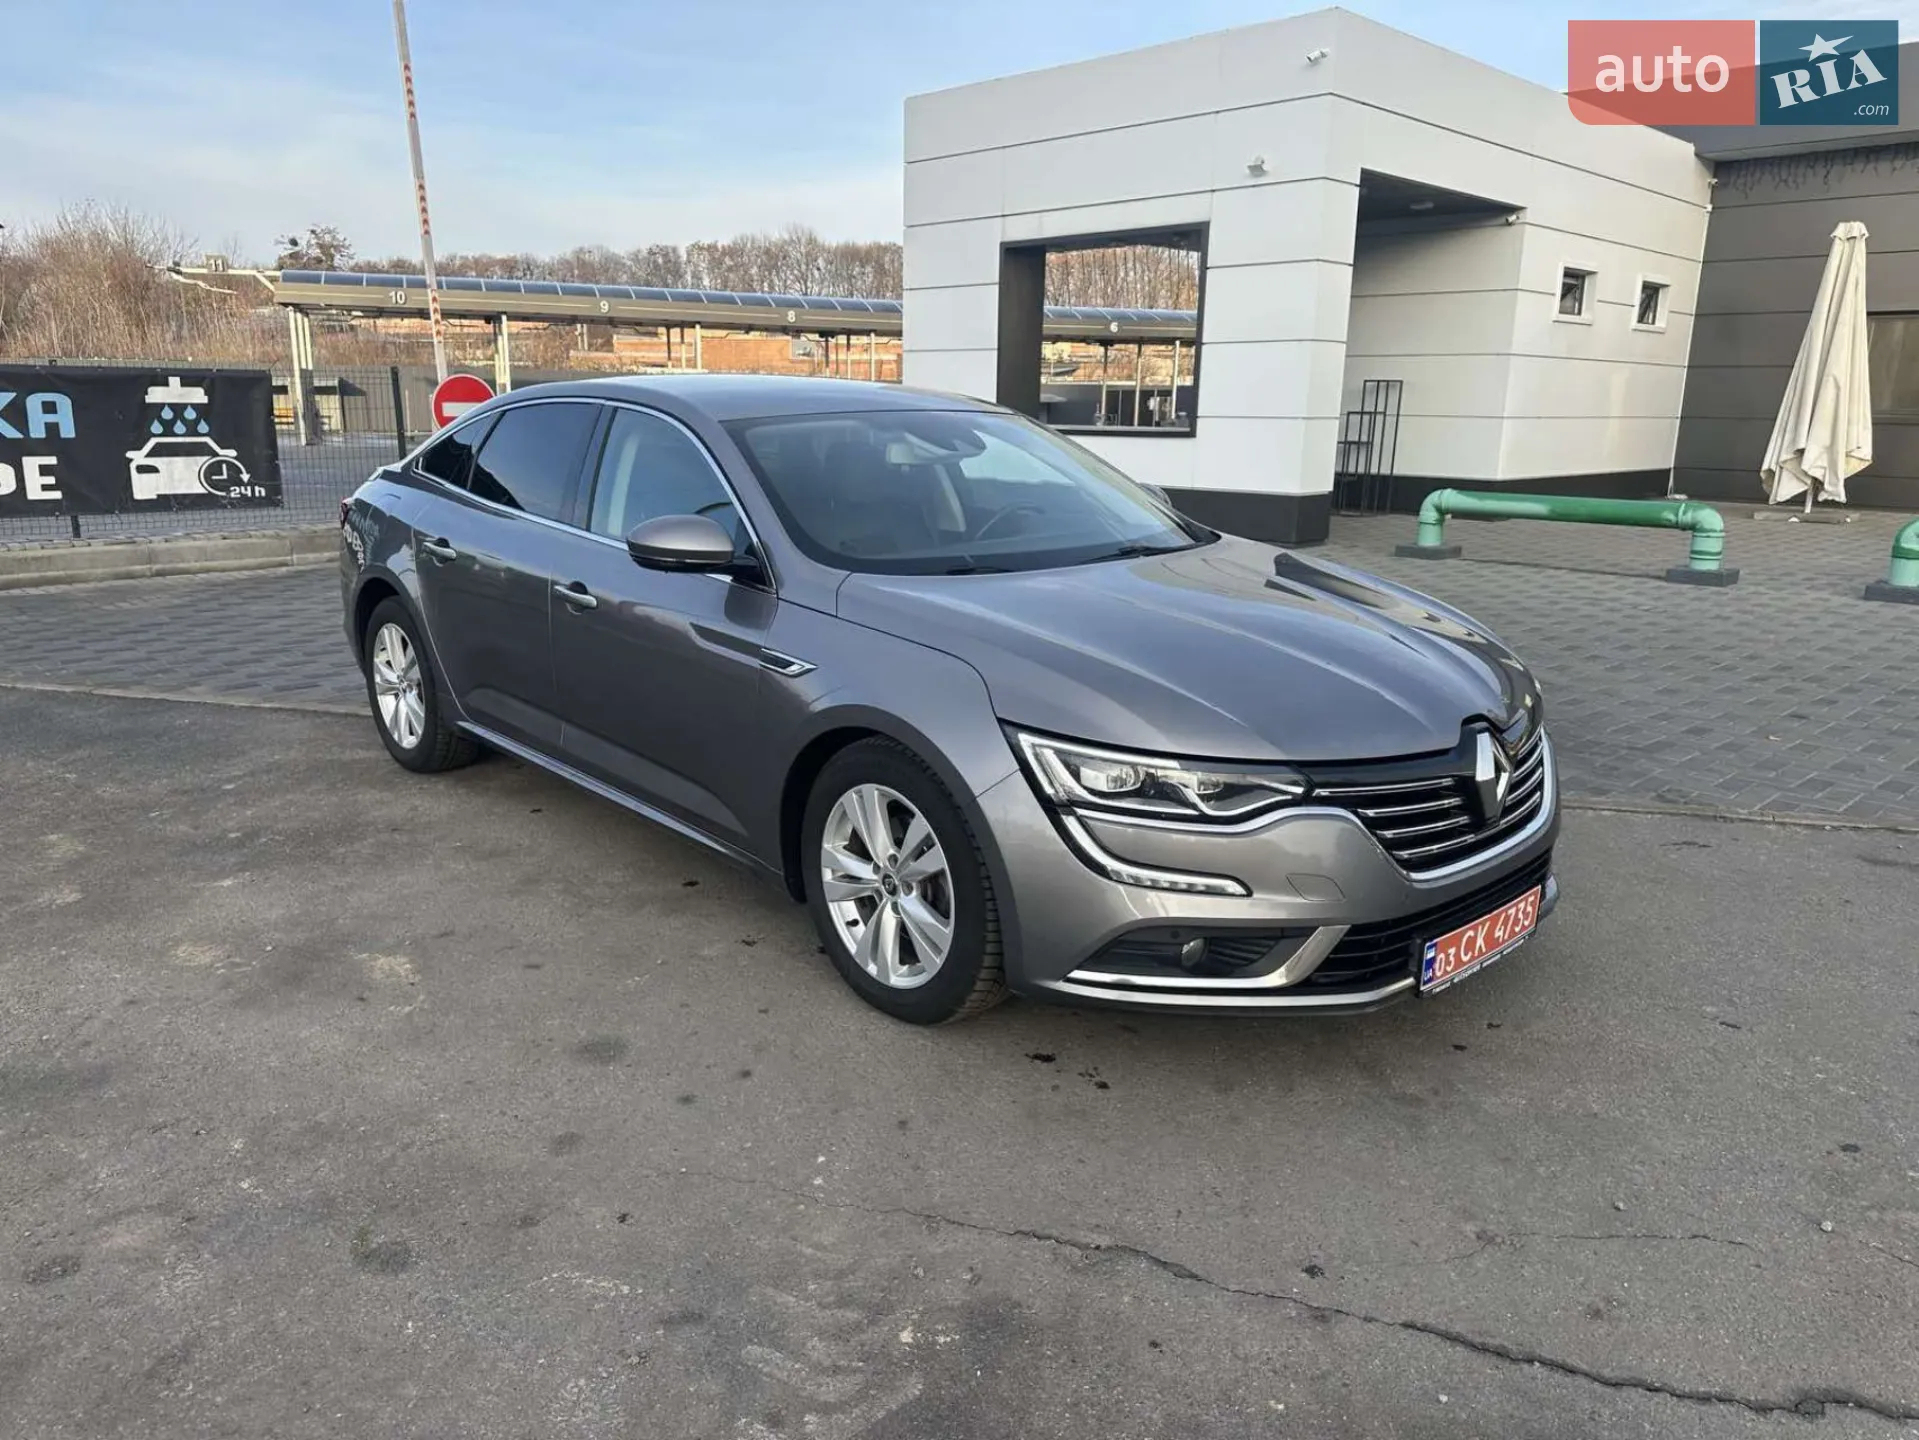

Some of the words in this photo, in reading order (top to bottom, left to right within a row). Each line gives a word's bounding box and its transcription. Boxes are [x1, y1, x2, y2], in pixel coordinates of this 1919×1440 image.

[209, 258, 224, 272] 11
[389, 290, 406, 305] 10
[599, 299, 609, 313] 9
[787, 309, 796, 322] 8
[1109, 321, 1119, 333] 6
[1434, 945, 1457, 978] 03
[1460, 921, 1491, 963] CK
[1494, 895, 1536, 943] 4735
